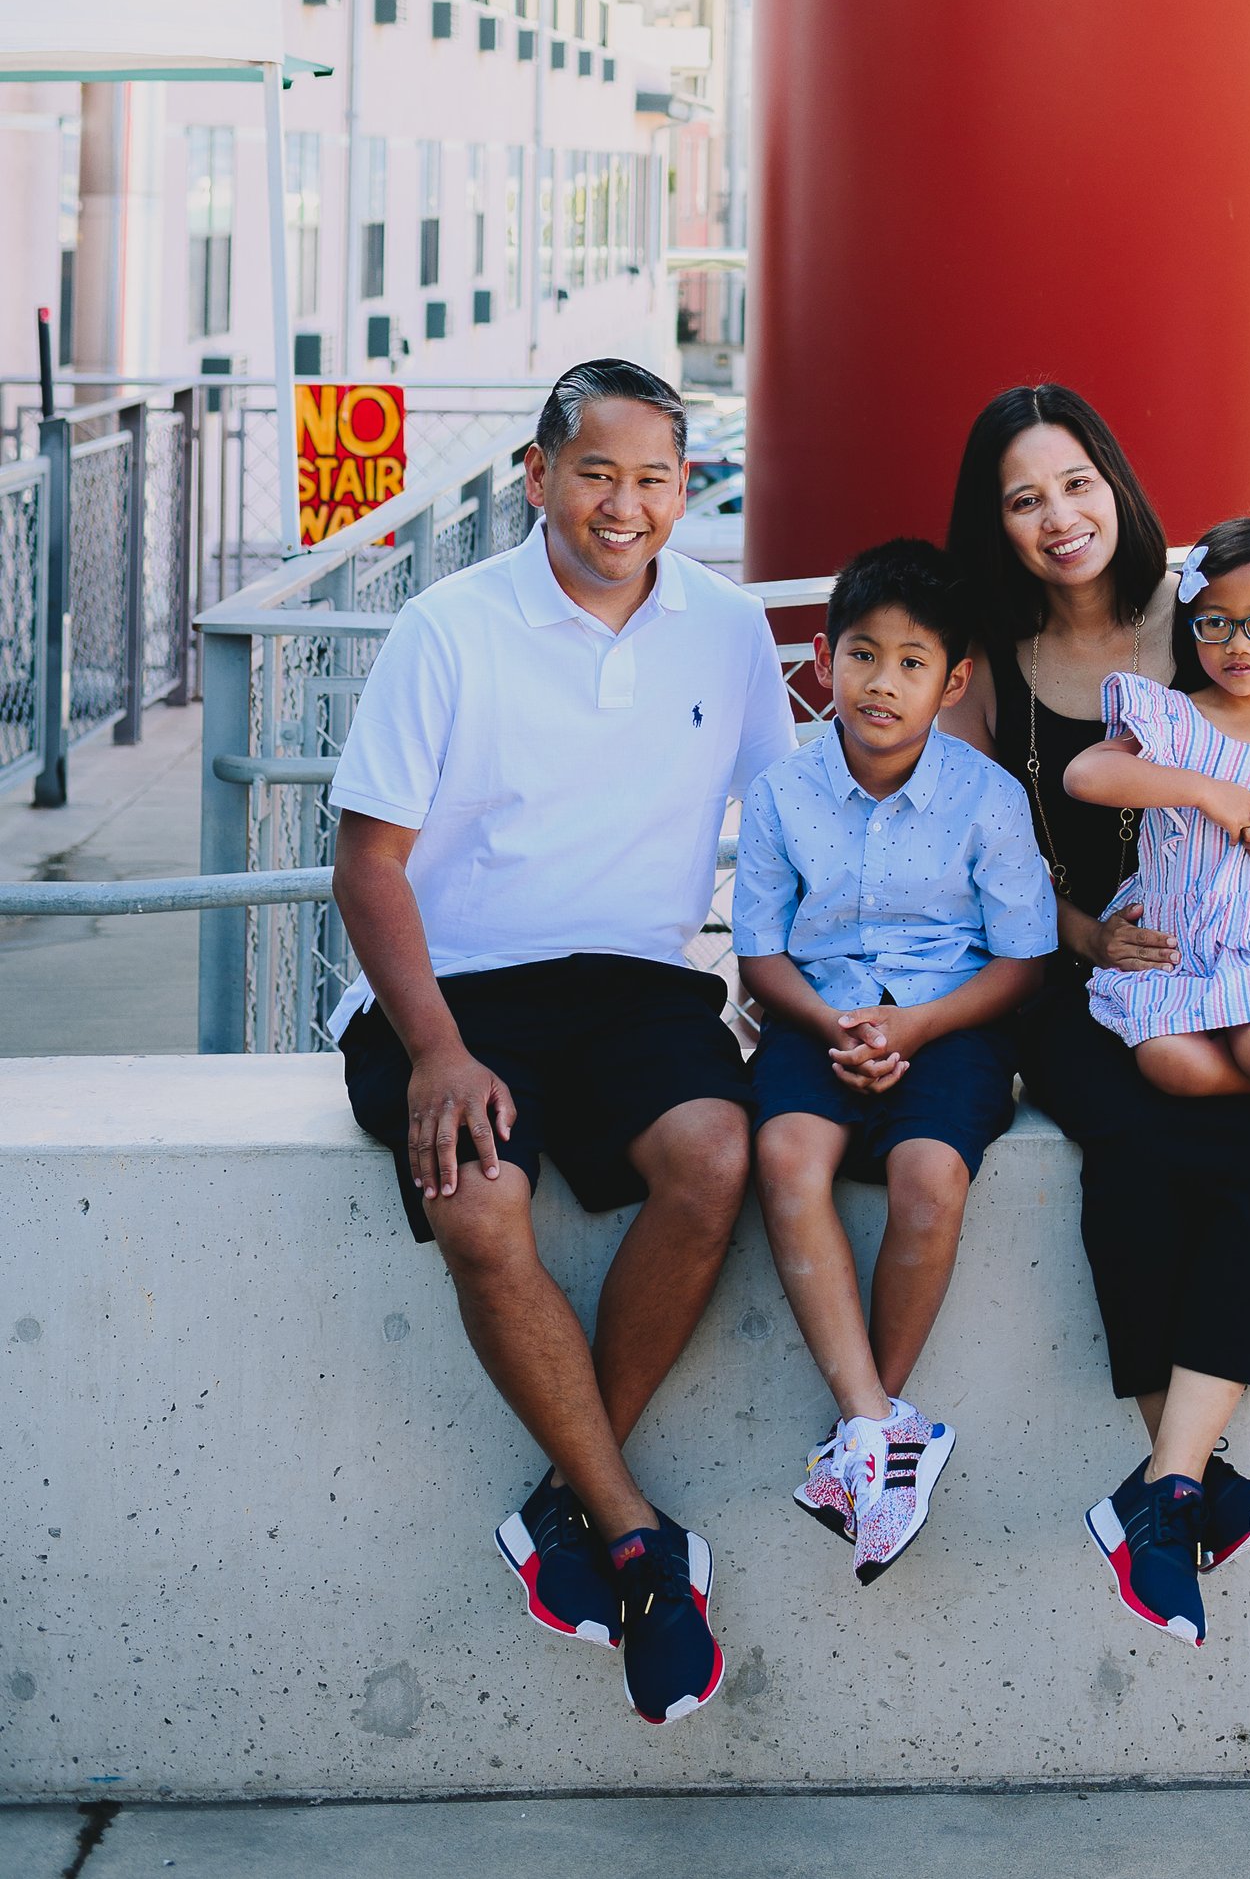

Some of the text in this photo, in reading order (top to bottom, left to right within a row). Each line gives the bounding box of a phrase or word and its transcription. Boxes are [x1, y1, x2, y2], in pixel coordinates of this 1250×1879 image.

[295, 385, 400, 457] NO
[298, 456, 404, 502] STAIR
[300, 503, 385, 545] WA
